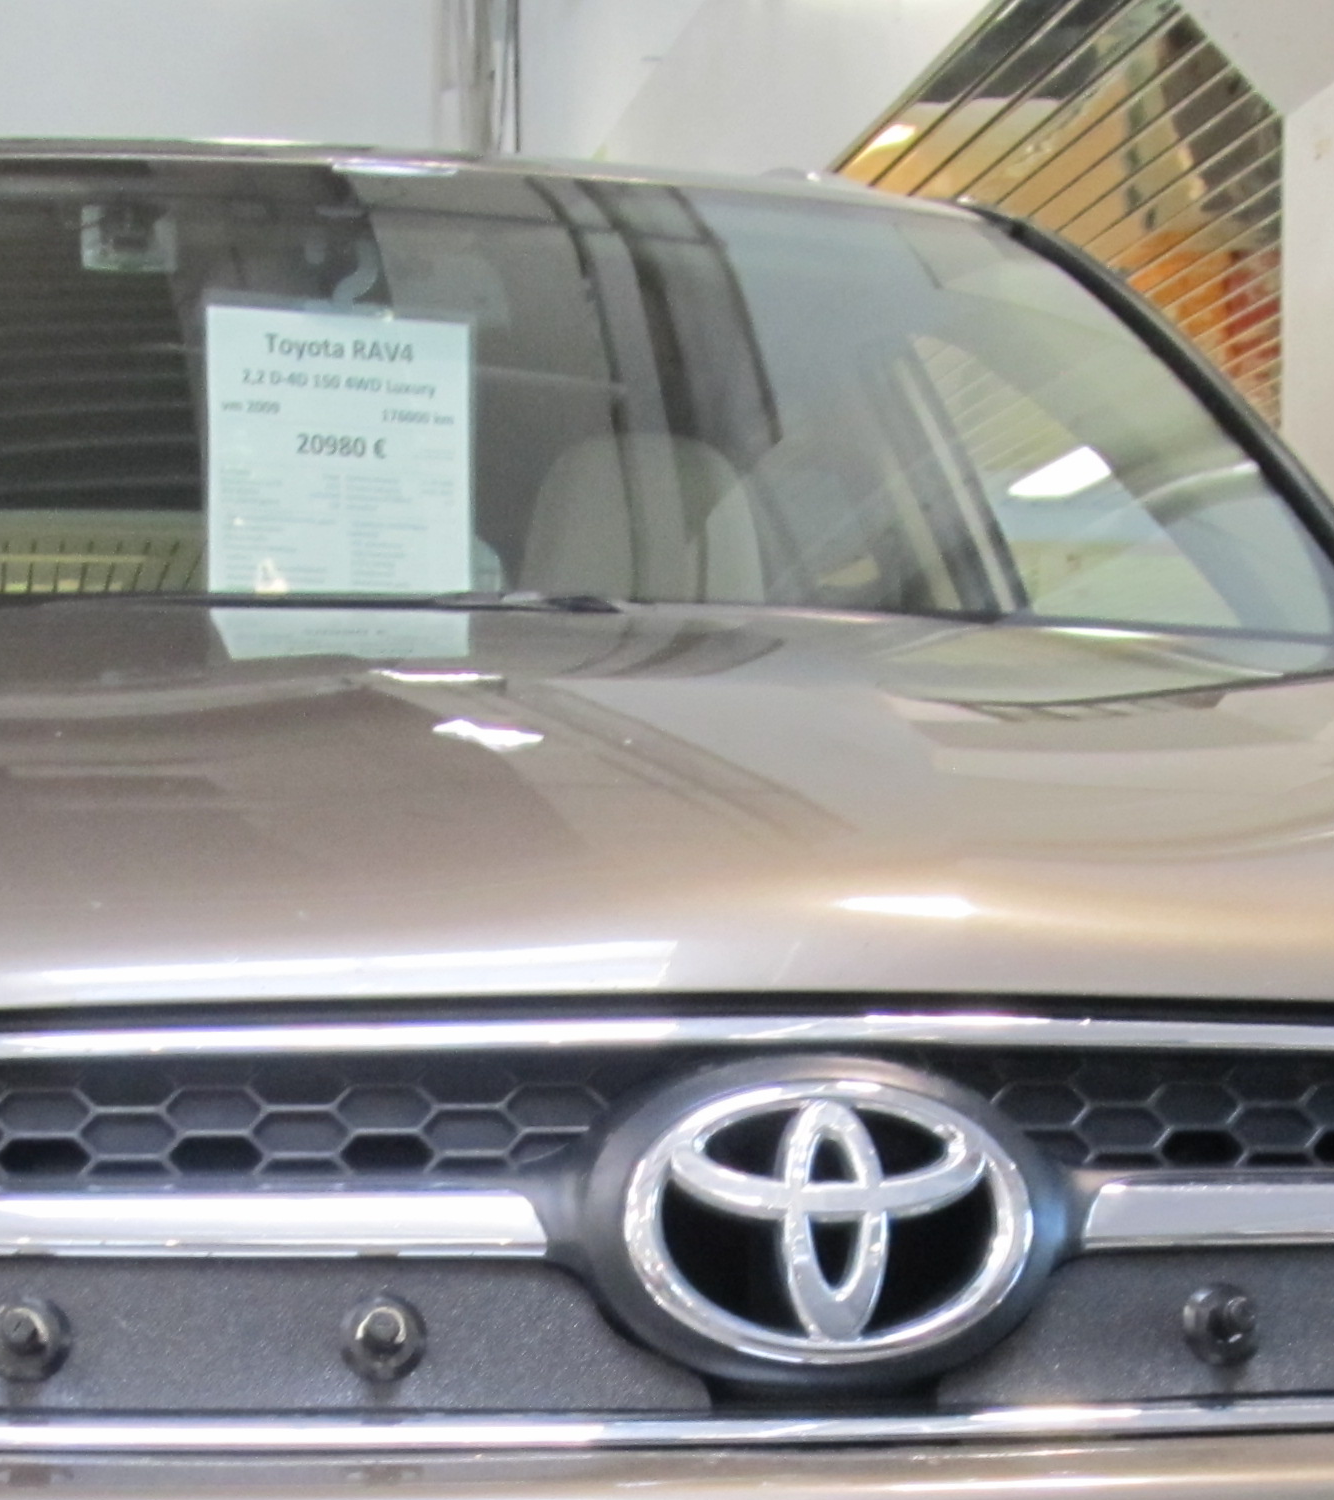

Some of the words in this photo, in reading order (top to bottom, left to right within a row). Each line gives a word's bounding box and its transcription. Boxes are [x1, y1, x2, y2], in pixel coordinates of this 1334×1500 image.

[265, 333, 345, 361] Toyota
[352, 338, 415, 363] RAV4
[242, 368, 266, 385] 2,2
[269, 370, 309, 388] D-4D
[344, 376, 382, 393] 4WD
[384, 378, 436, 399] Luxury
[296, 432, 366, 458] 20980
[373, 437, 387, 460] €
